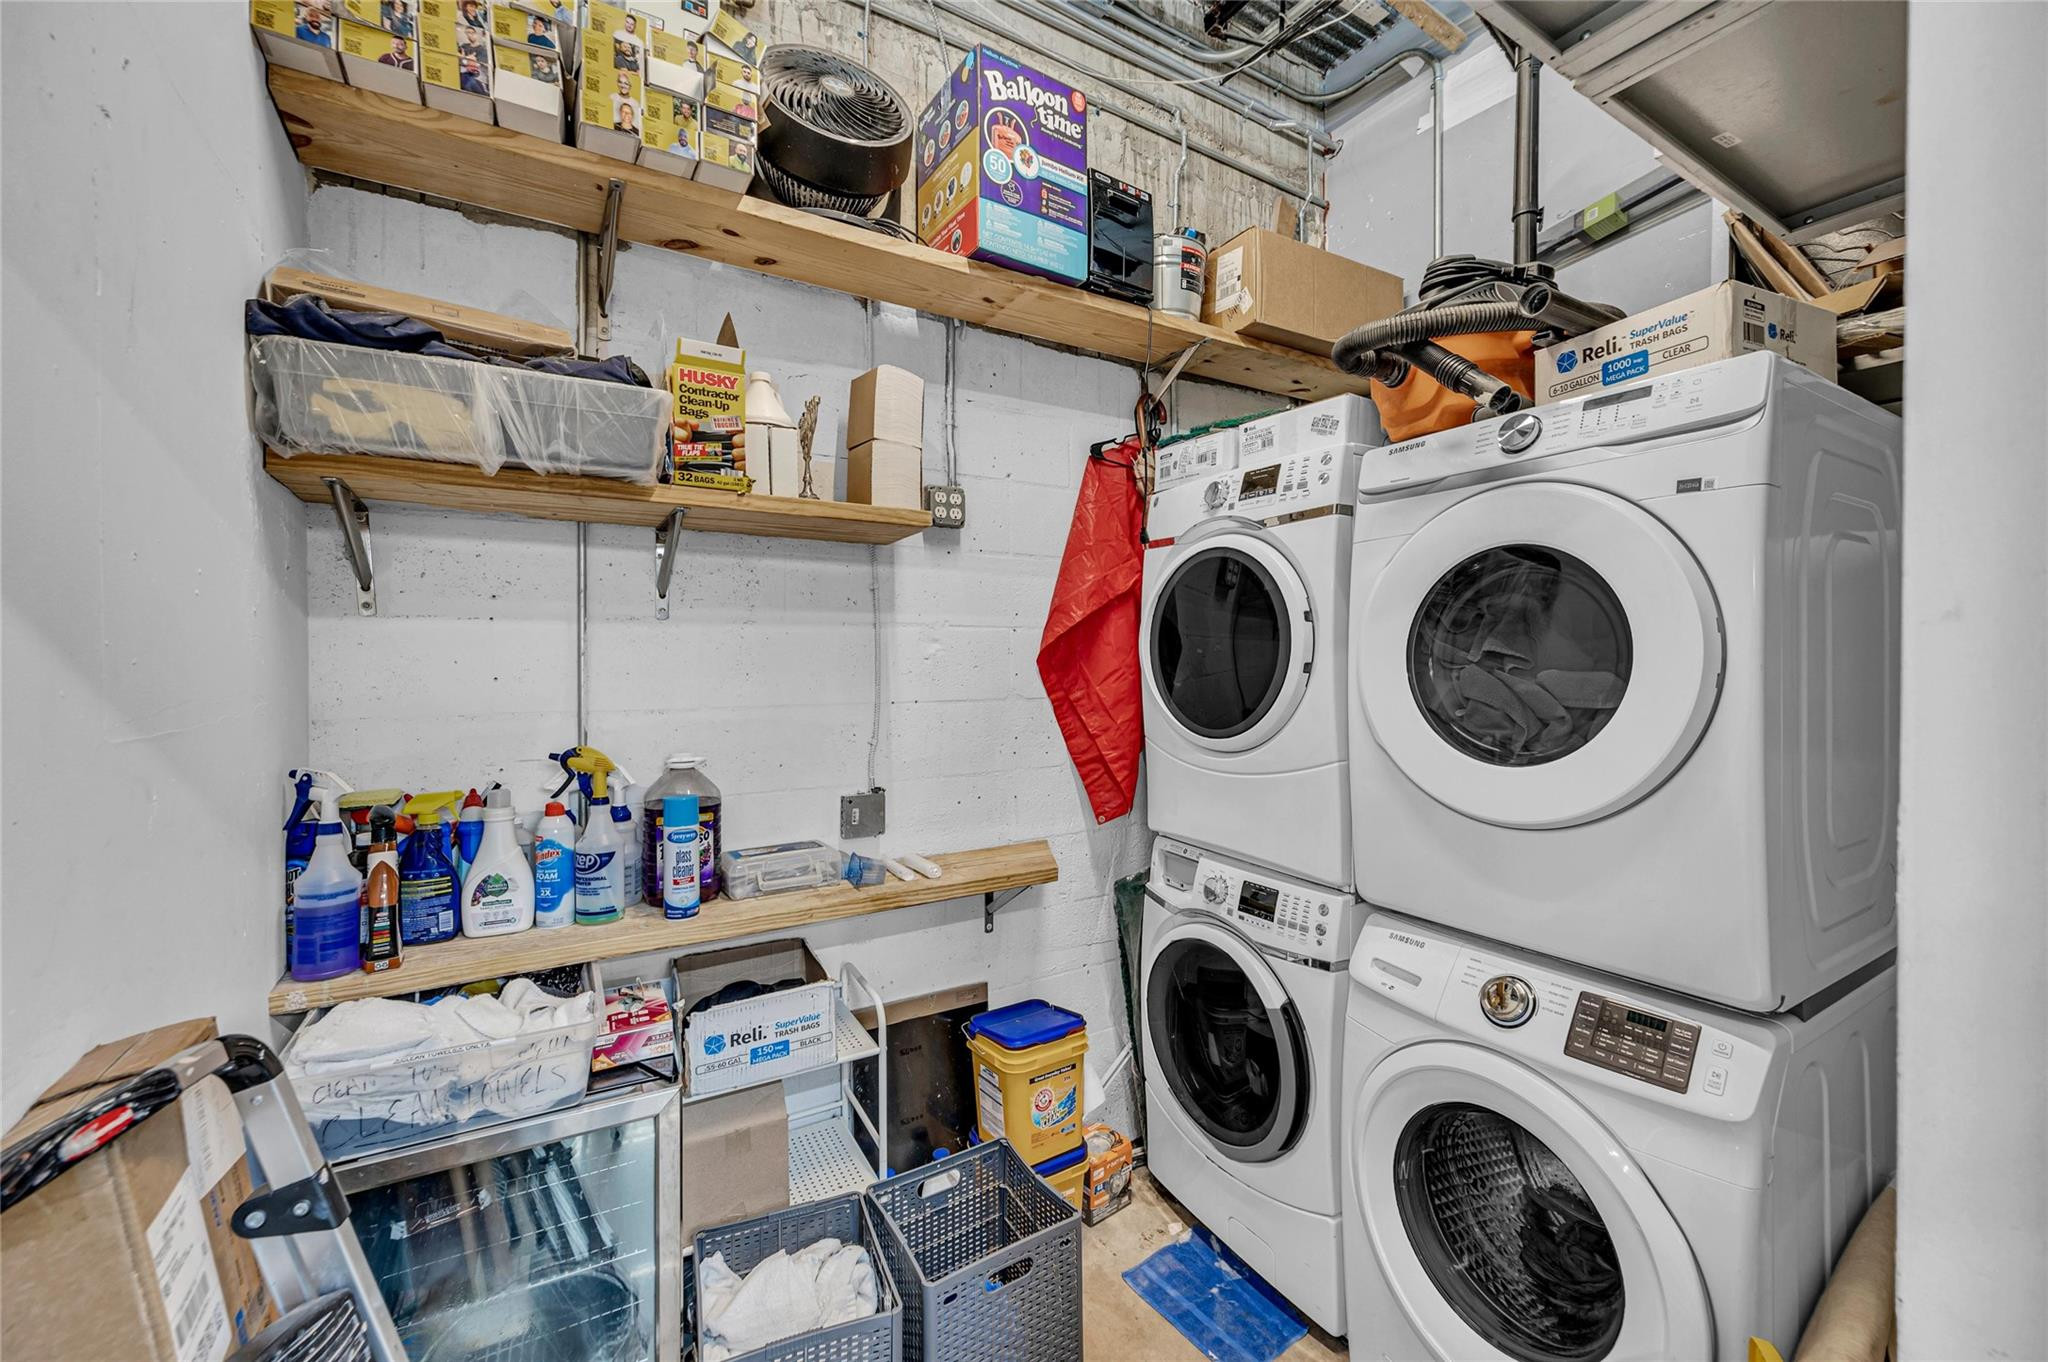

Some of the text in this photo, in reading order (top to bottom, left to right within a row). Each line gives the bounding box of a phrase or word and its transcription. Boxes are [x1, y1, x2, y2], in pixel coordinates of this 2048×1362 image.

[984, 70, 1068, 116] Balloon
[1037, 106, 1082, 139] time
[989, 155, 1006, 173] 50
[1629, 312, 1688, 340] SuperValue
[1630, 324, 1688, 350] TRASH BAGS
[1582, 336, 1622, 364] Reli.
[1662, 343, 1691, 360] CLEAR
[1605, 365, 1646, 383] MEGA PACK
[1607, 358, 1632, 373] 1000
[679, 367, 739, 390] HUSKY
[1552, 373, 1600, 395] 6-10 GALLON
[679, 384, 740, 402] Contractor
[679, 406, 710, 420] Bags
[1388, 440, 1426, 456] SAMSUNG
[678, 472, 693, 482] 32
[693, 476, 716, 485] BAGS
[675, 849, 692, 865] glass
[672, 864, 694, 879] cleaner
[540, 889, 551, 897] 2X
[1388, 932, 1426, 949] SAMSUNG
[774, 1013, 821, 1030] SuperValue
[774, 1021, 820, 1038] TRASH BAGS
[730, 1025, 767, 1048] Reli.
[799, 1037, 821, 1047] BLACK
[752, 1051, 788, 1064] MEGA PACK
[757, 1046, 774, 1056] 150
